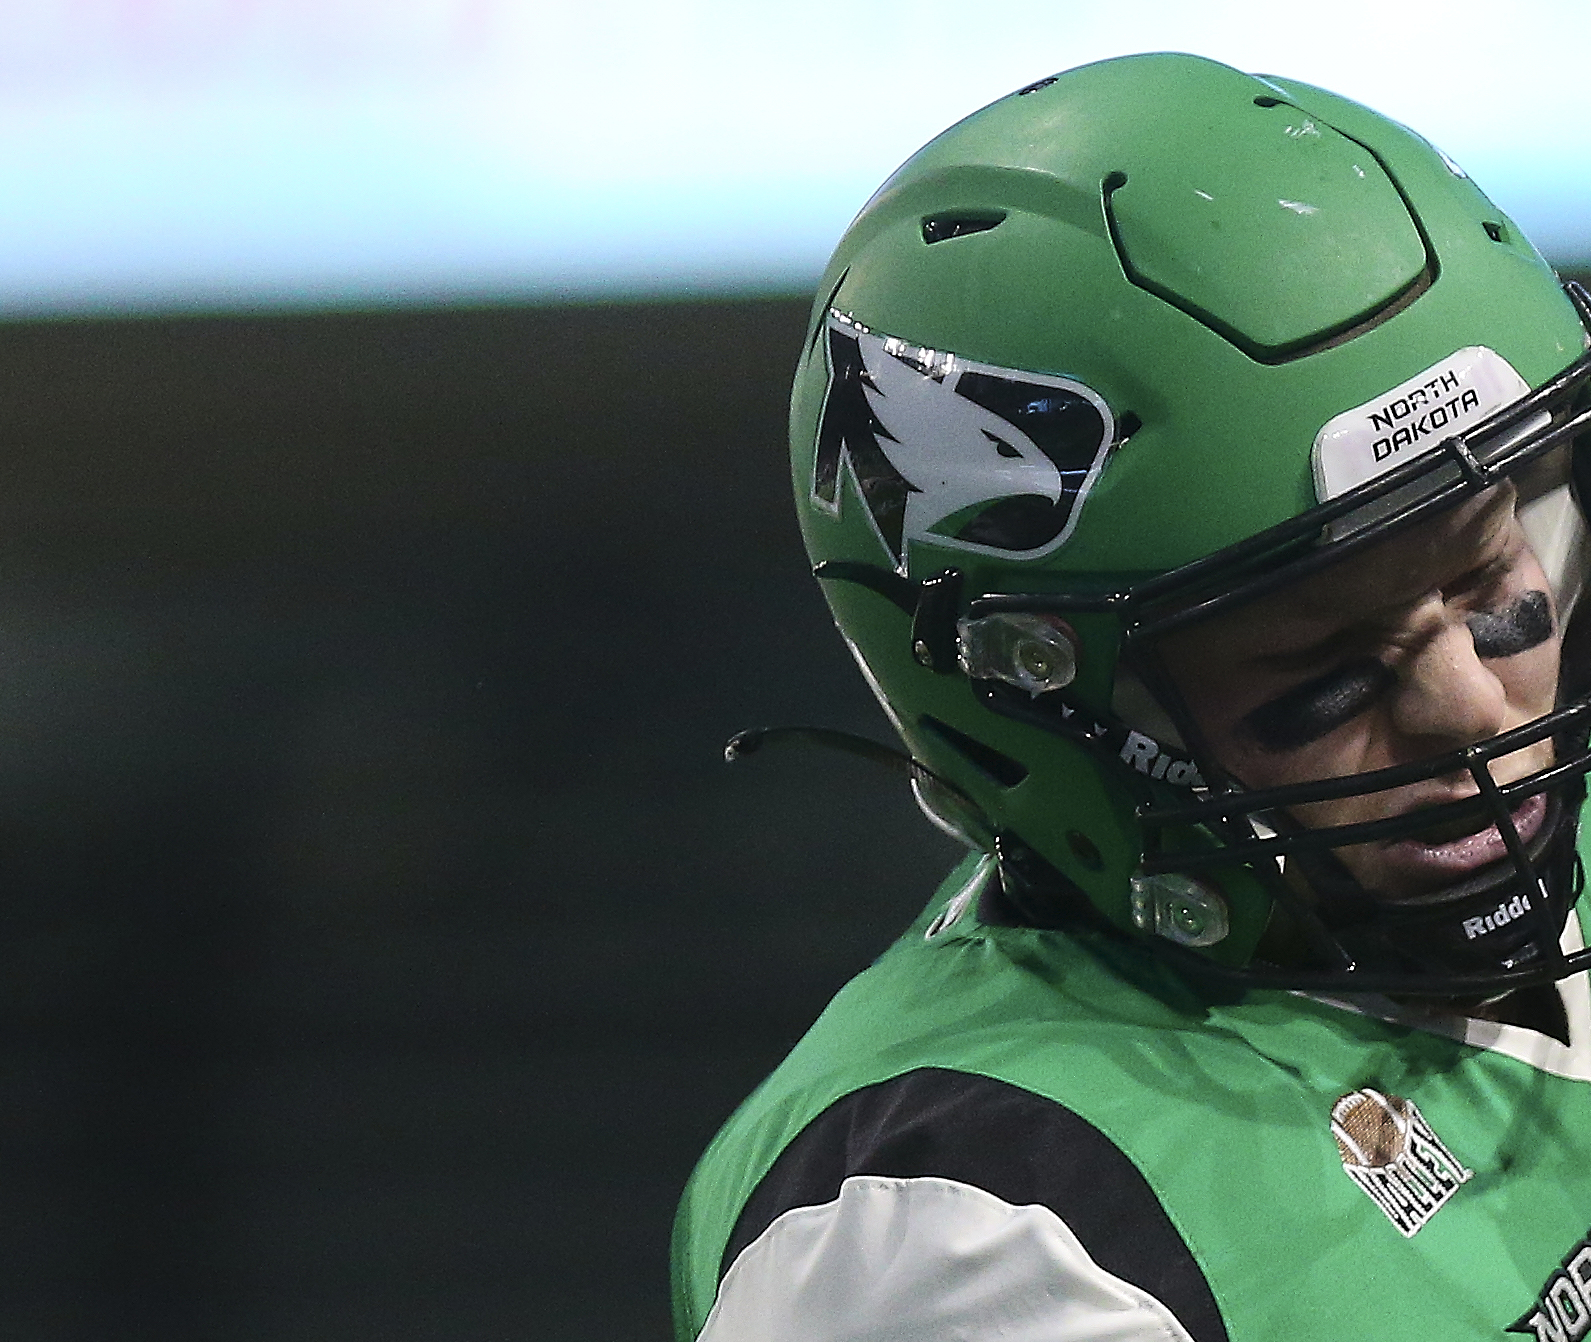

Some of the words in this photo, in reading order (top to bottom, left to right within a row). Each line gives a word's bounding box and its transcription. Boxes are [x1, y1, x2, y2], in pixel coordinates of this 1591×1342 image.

[1366, 369, 1460, 432] NORTH
[1371, 388, 1480, 463] DAKOTA
[1342, 1098, 1474, 1239] VALLEY
